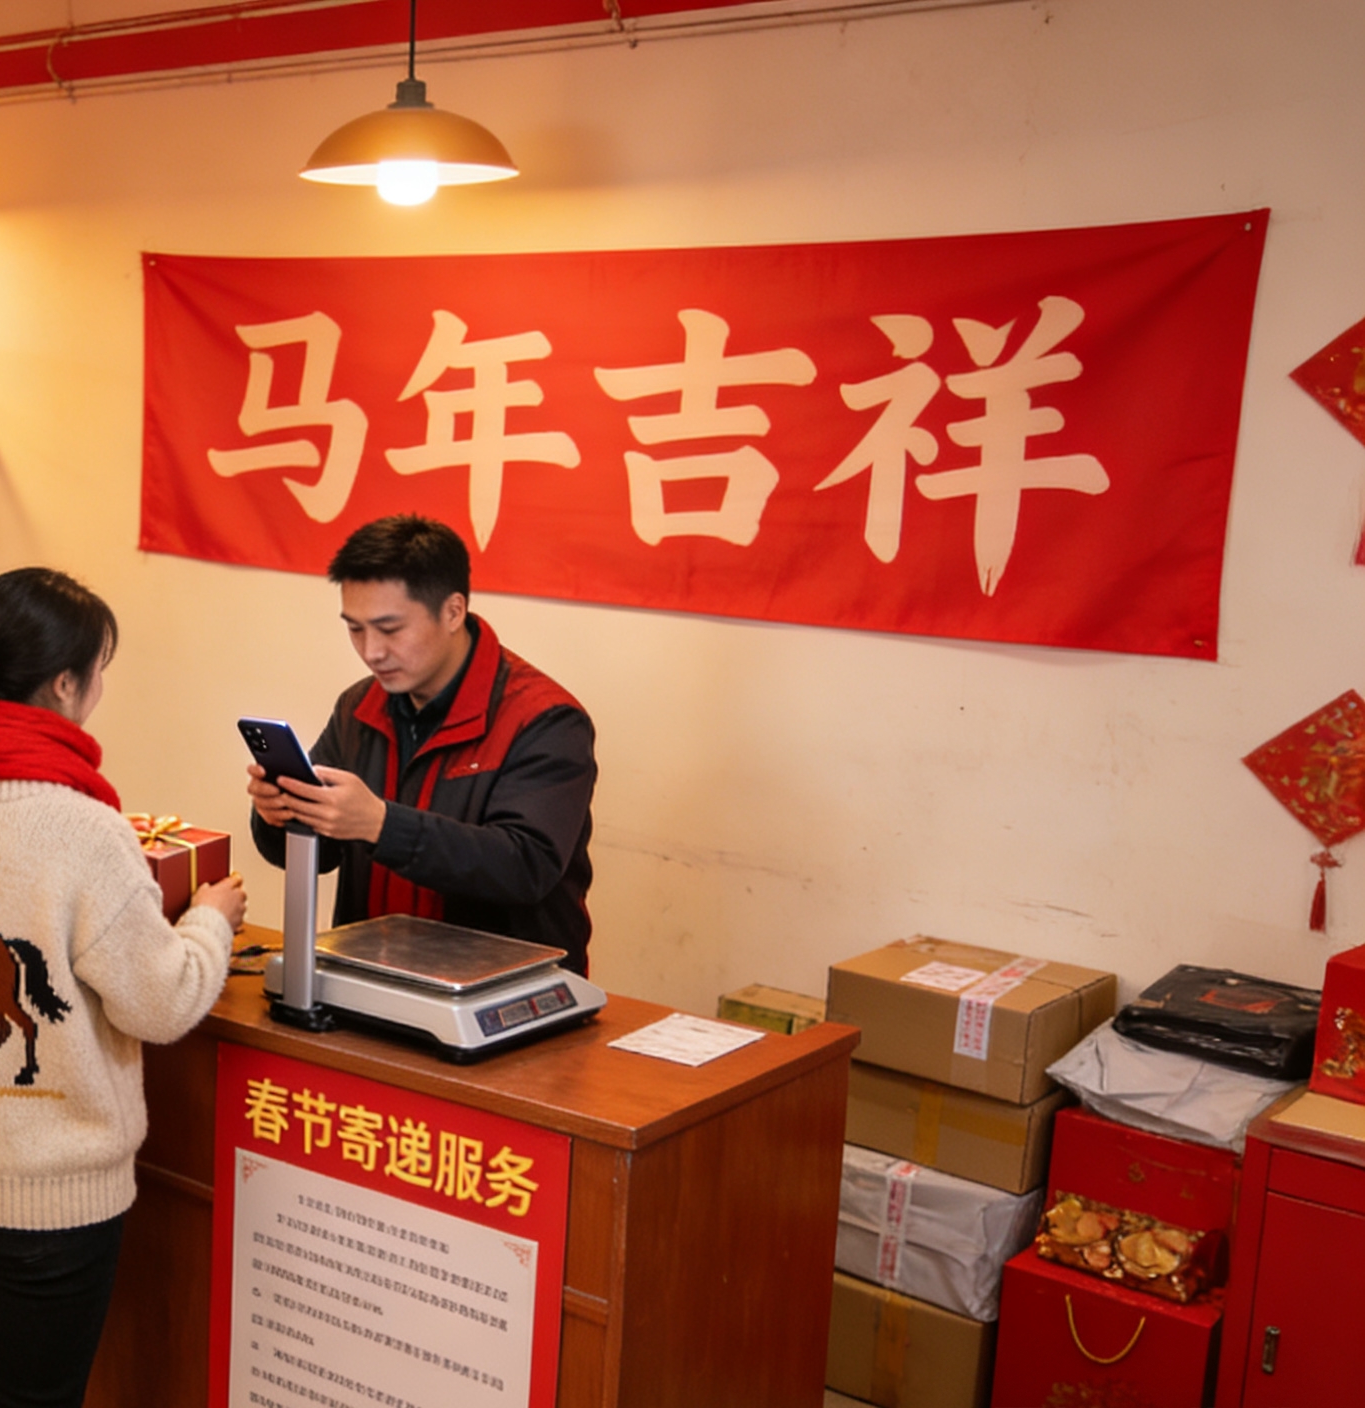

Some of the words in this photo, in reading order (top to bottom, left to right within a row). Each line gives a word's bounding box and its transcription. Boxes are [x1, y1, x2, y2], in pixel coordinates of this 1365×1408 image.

[206, 296, 1110, 598] 马年吉祥
[244, 1078, 539, 1217] 春节寄递服务
